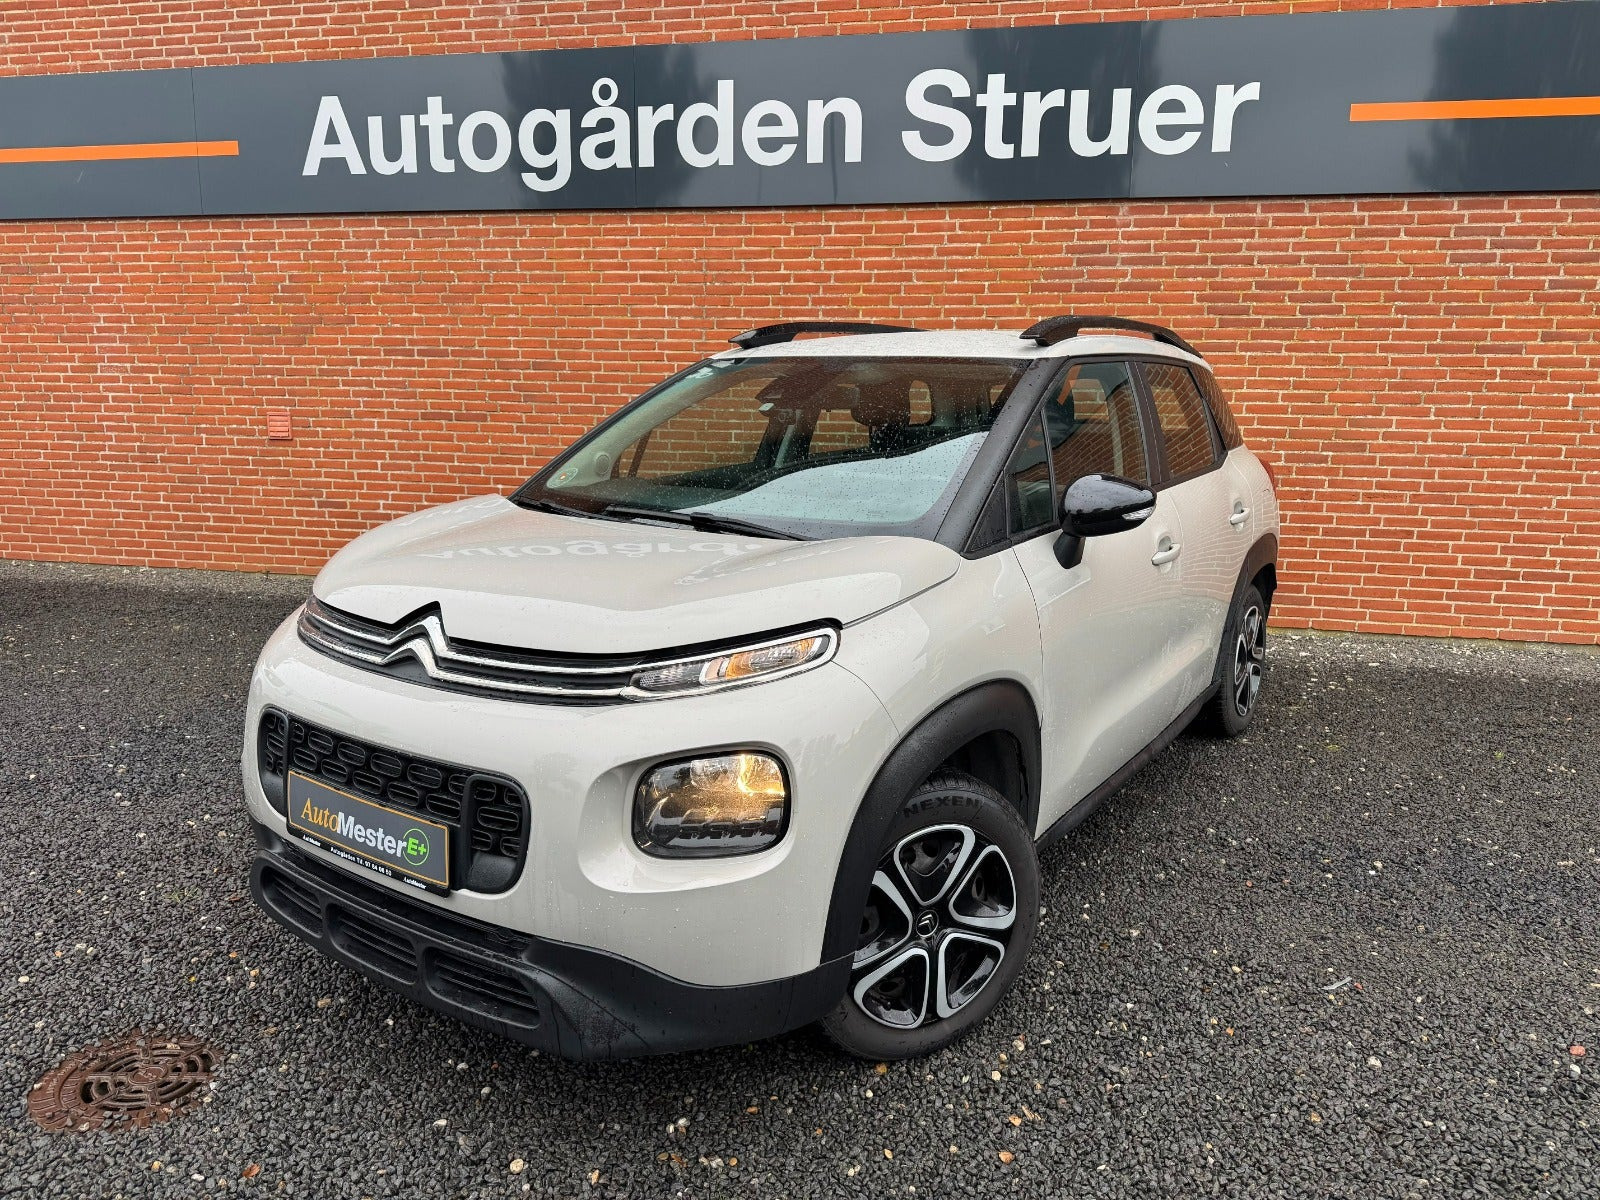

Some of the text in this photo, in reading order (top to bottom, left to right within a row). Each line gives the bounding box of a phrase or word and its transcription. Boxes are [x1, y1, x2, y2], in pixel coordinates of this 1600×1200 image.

[302, 68, 1260, 193] Autogården Struer
[902, 795, 981, 818] NEXEN
